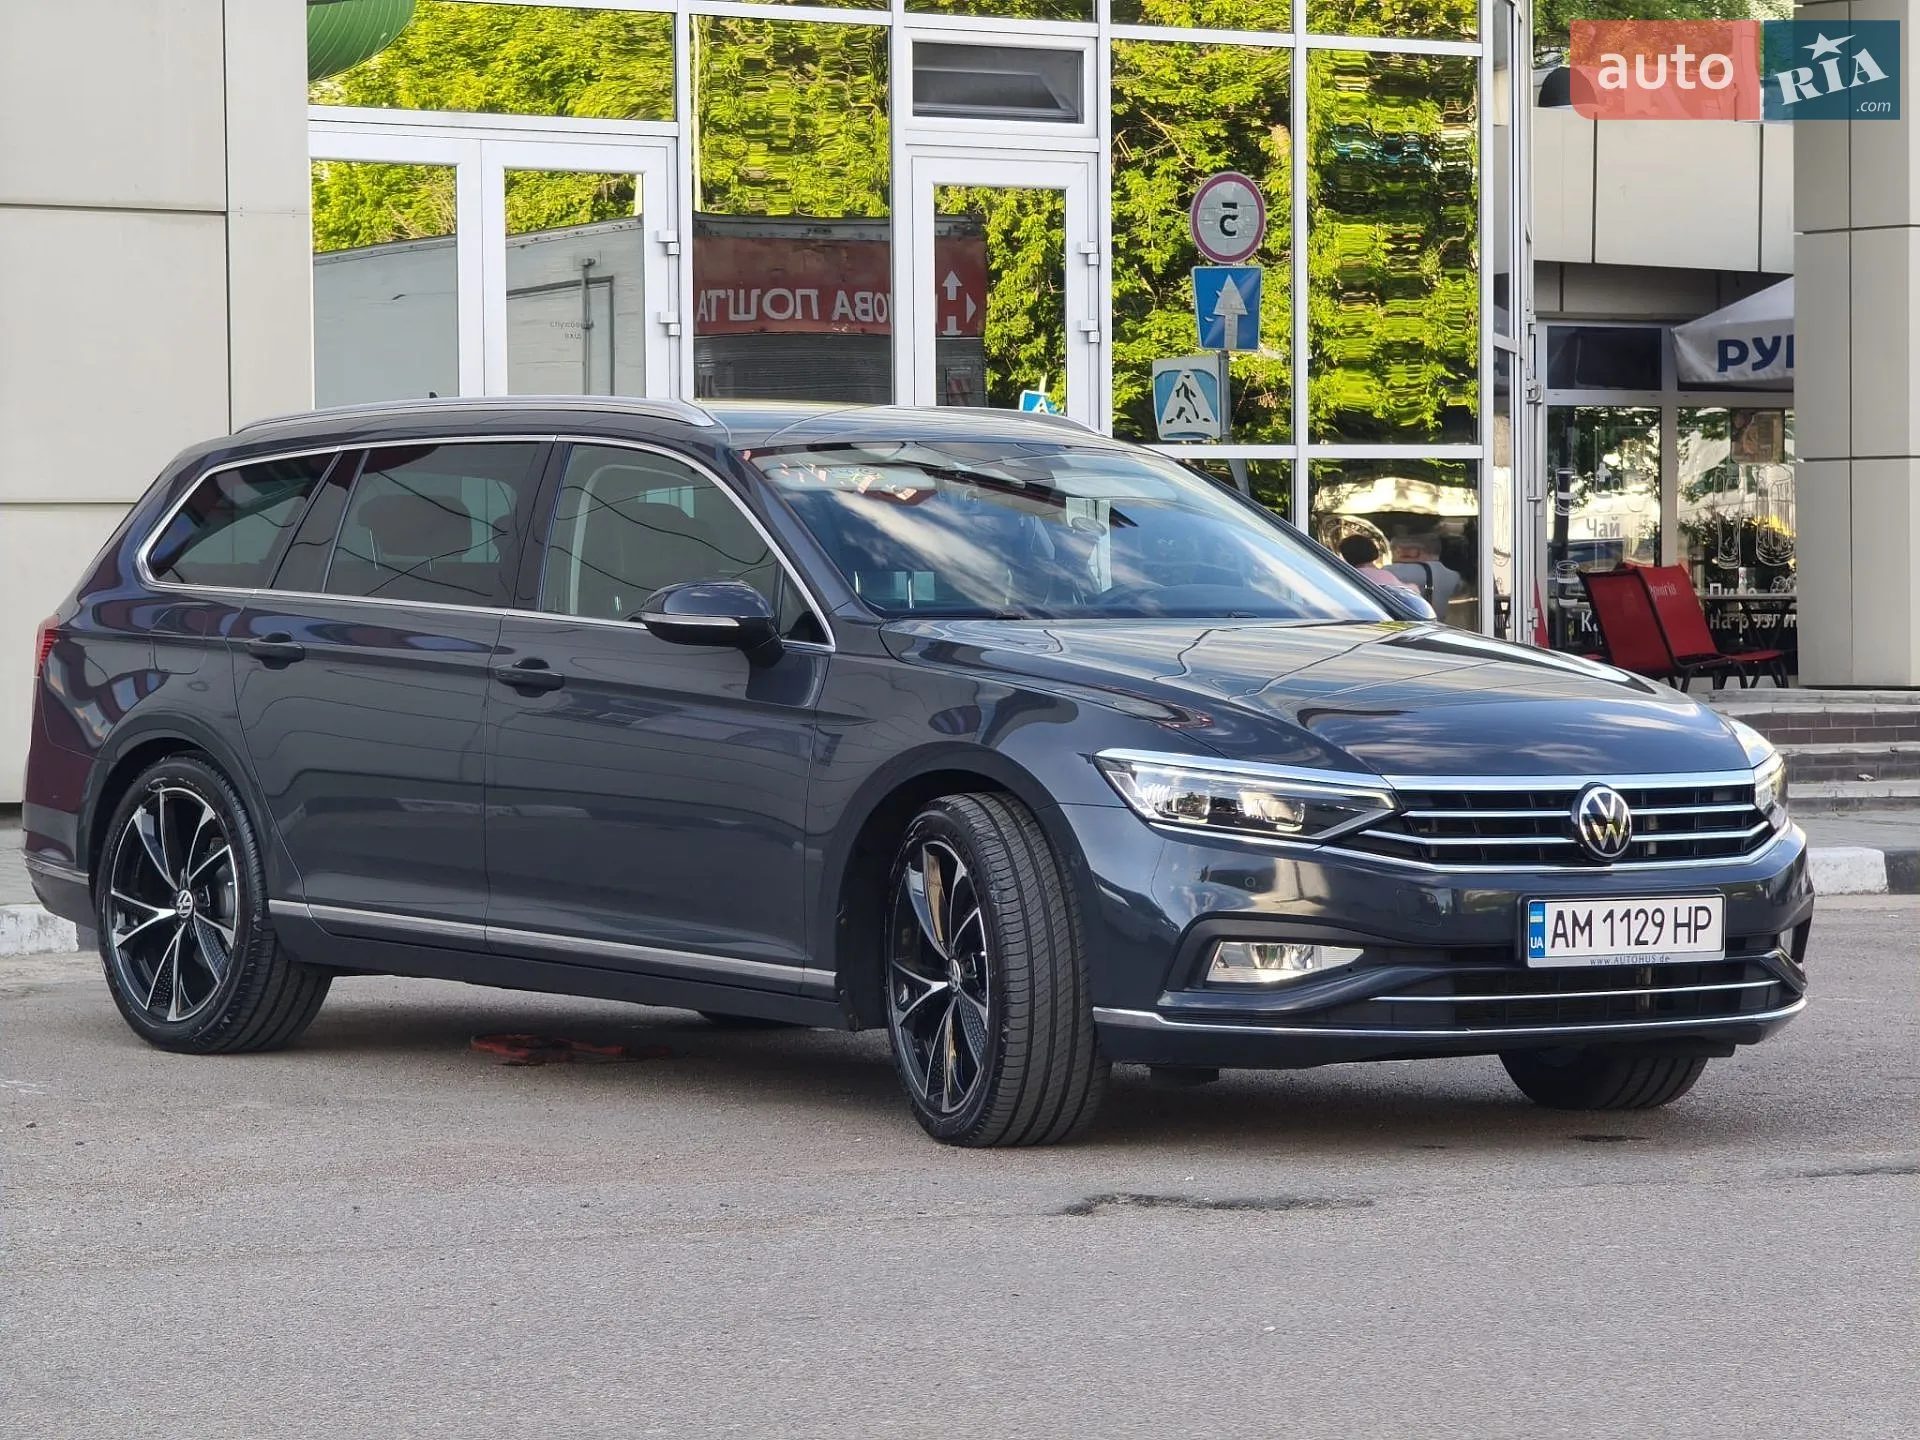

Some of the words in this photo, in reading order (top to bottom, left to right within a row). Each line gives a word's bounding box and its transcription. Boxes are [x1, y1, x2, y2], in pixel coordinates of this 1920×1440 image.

[1586, 515, 1621, 538] Чай
[1550, 909, 1594, 949] AM
[1602, 907, 1666, 947] 1129
[1673, 905, 1713, 945] HP
[1530, 936, 1544, 949] UA
